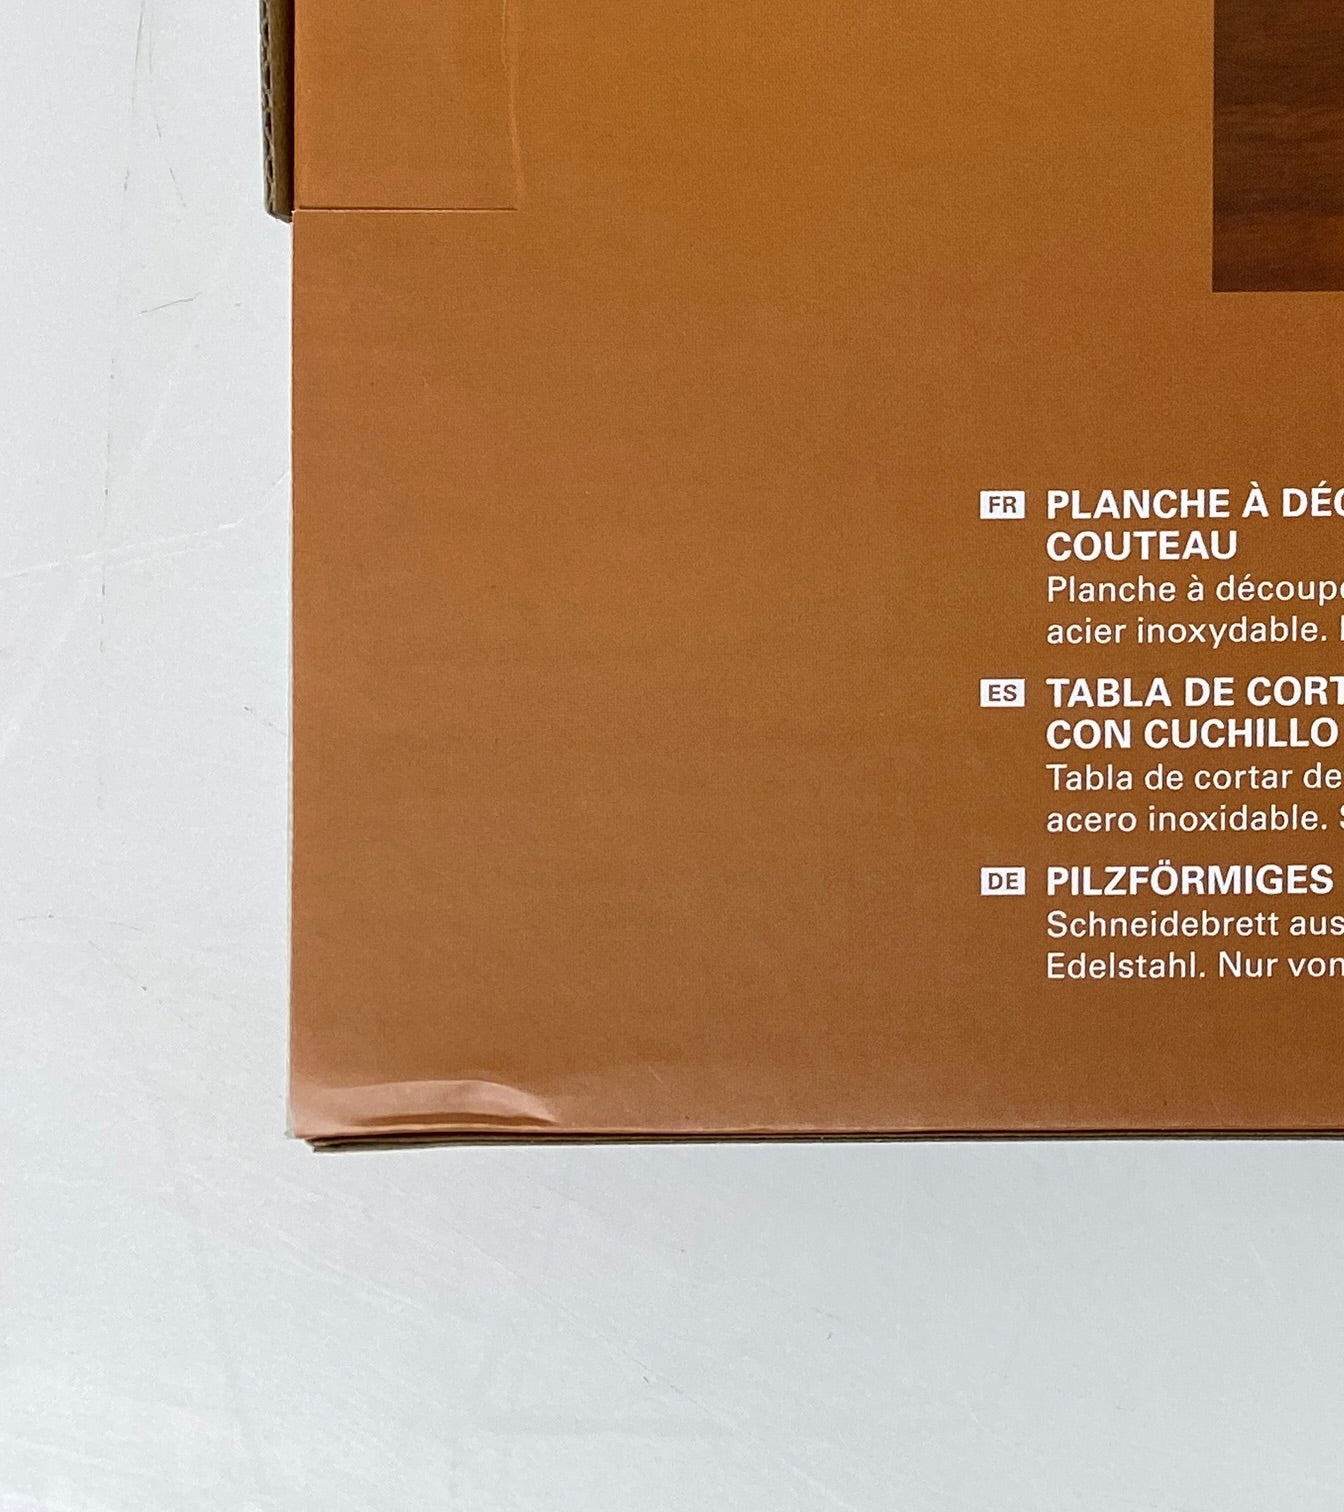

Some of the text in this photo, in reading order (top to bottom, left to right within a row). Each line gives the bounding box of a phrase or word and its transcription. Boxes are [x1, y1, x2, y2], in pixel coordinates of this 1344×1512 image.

[988, 495, 1017, 514] FR
[1047, 488, 1230, 520] PLANCHE
[1241, 480, 1270, 518] À
[1046, 530, 1237, 562] COUTEAU
[1048, 575, 1176, 603] Planche
[1187, 574, 1204, 602] à
[1047, 617, 1127, 645] acier
[1137, 615, 1327, 649] inoxydable.
[988, 684, 1018, 702] ES
[1045, 677, 1172, 708] TABLA
[1185, 676, 1235, 707] DE
[1046, 717, 1339, 750] CON CUCHILLO
[1045, 763, 1133, 791] Tabla
[1144, 763, 1184, 791] de
[1194, 765, 1293, 790] cortar
[1303, 761, 1342, 789] de
[1046, 812, 1137, 833] acero
[1148, 803, 1327, 832] inoxidable.
[988, 872, 1019, 890] DE
[1047, 859, 1334, 896] PILZFÖRMIGES
[1047, 909, 1279, 938] Schneidebrett
[1047, 951, 1205, 979] Edelstahl.
[1219, 950, 1279, 978] Nur
